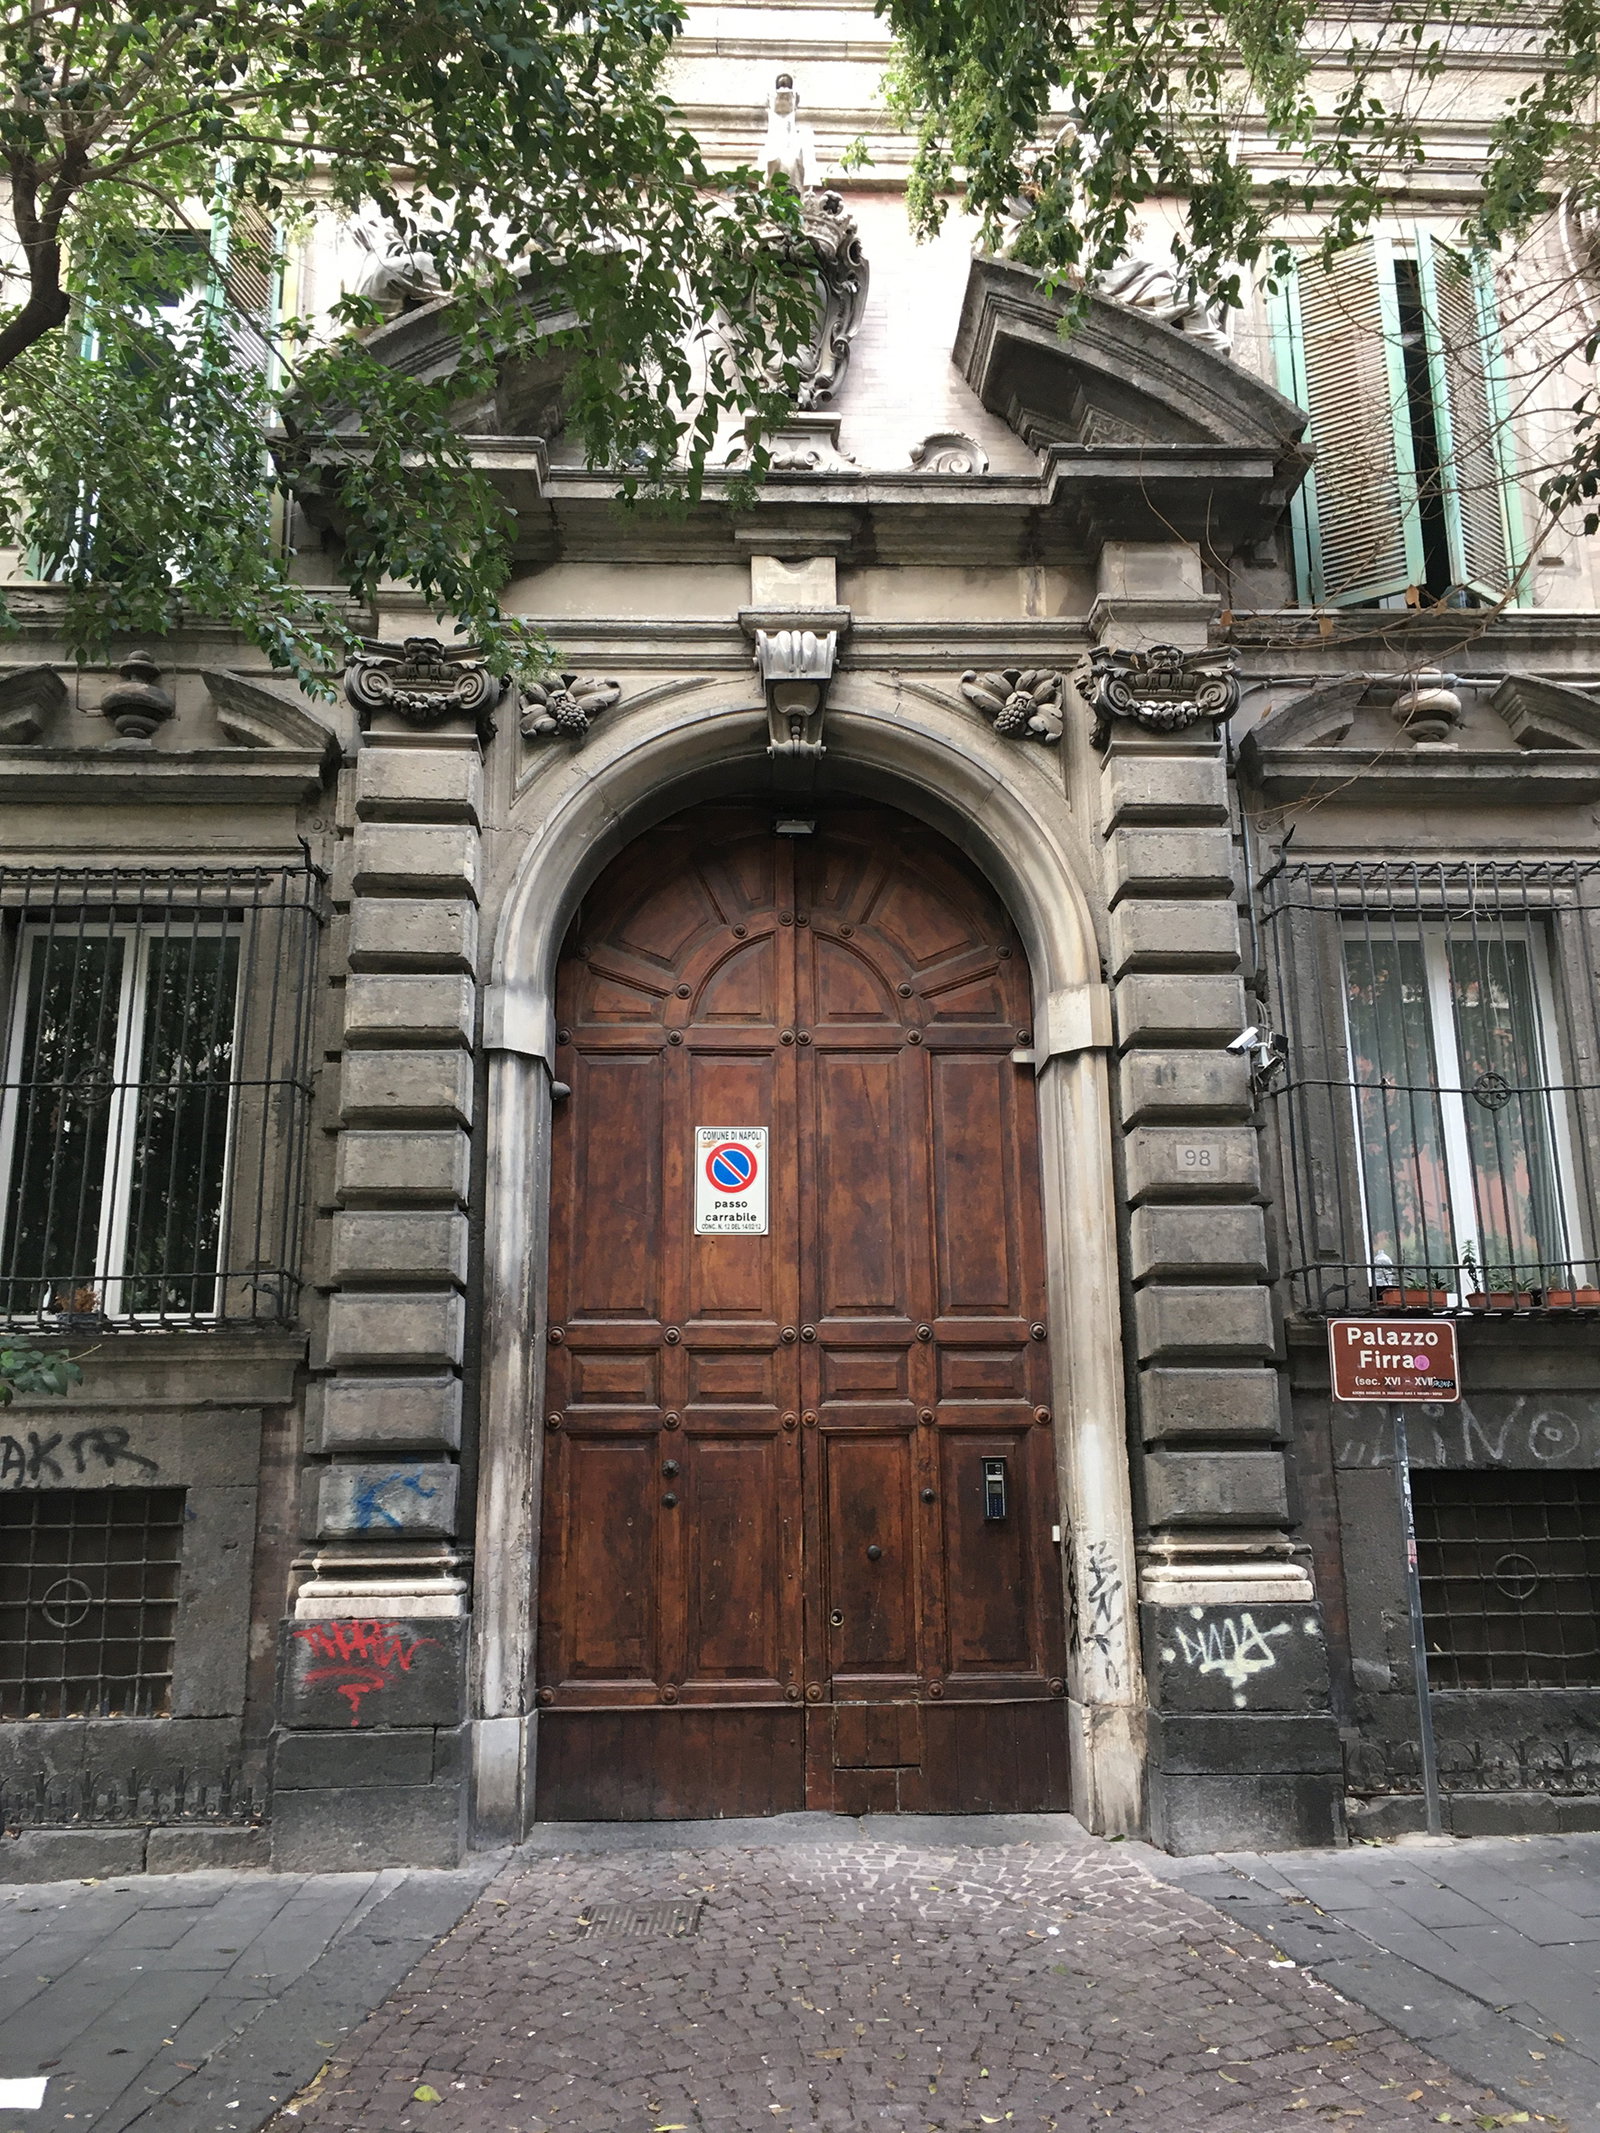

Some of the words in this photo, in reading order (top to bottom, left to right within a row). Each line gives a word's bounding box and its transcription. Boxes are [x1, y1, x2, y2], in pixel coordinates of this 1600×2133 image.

[702, 1131, 729, 1140] COMUNE
[731, 1131, 738, 1140] DI
[739, 1131, 762, 1140] NAPOLI
[1185, 1150, 1211, 1166] 98
[714, 1201, 748, 1209] passo
[705, 1212, 757, 1221] carrabile
[1346, 1326, 1439, 1346] Palazzo
[1360, 1350, 1428, 1370] Firra
[1355, 1375, 1381, 1386] (sec.
[1384, 1376, 1401, 1386] XVI
